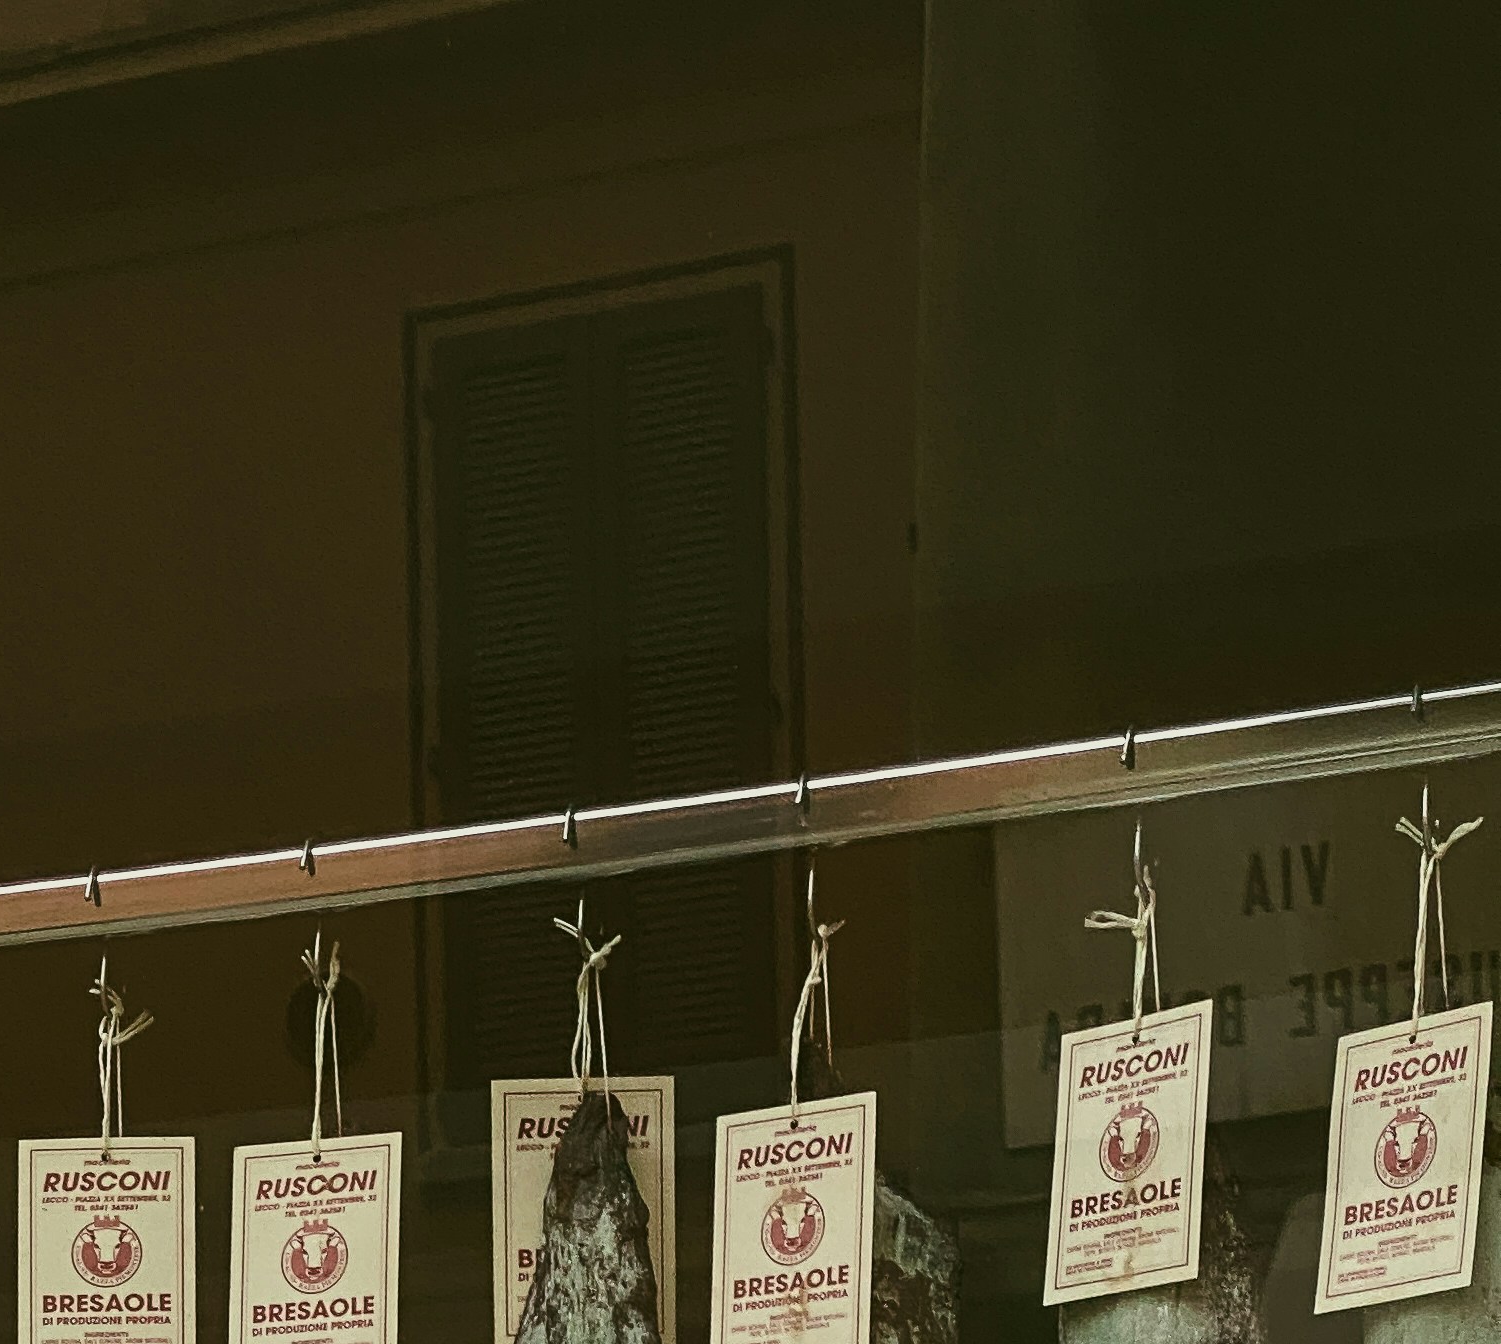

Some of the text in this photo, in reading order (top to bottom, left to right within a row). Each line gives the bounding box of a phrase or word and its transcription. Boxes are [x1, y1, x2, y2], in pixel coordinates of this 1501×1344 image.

[1079, 1043, 1190, 1089] RUSCONI
[1354, 1046, 1469, 1092] RUSCONI
[517, 1115, 650, 1139] RUSNI
[737, 1132, 853, 1170] RUSCONI
[43, 1170, 171, 1192] RUSCONI
[256, 1169, 378, 1200] RUSCONI
[1070, 1177, 1181, 1219] BRESAOLE
[1344, 1184, 1458, 1227] BRESAOLE
[1343, 1229, 1352, 1240] DI
[1415, 1209, 1456, 1225] PROPRIA
[733, 1265, 849, 1300] BRESAOLE
[42, 1294, 171, 1313] BRESAOLE
[252, 1296, 375, 1324] BRESAOLE
[733, 1302, 742, 1313] DI
[807, 1289, 848, 1302] PROPRIA
[42, 1316, 171, 1326] DI PRODUZIONE PROPRIA
[252, 1319, 374, 1337] DI PRODUZIONE PROPRIA
